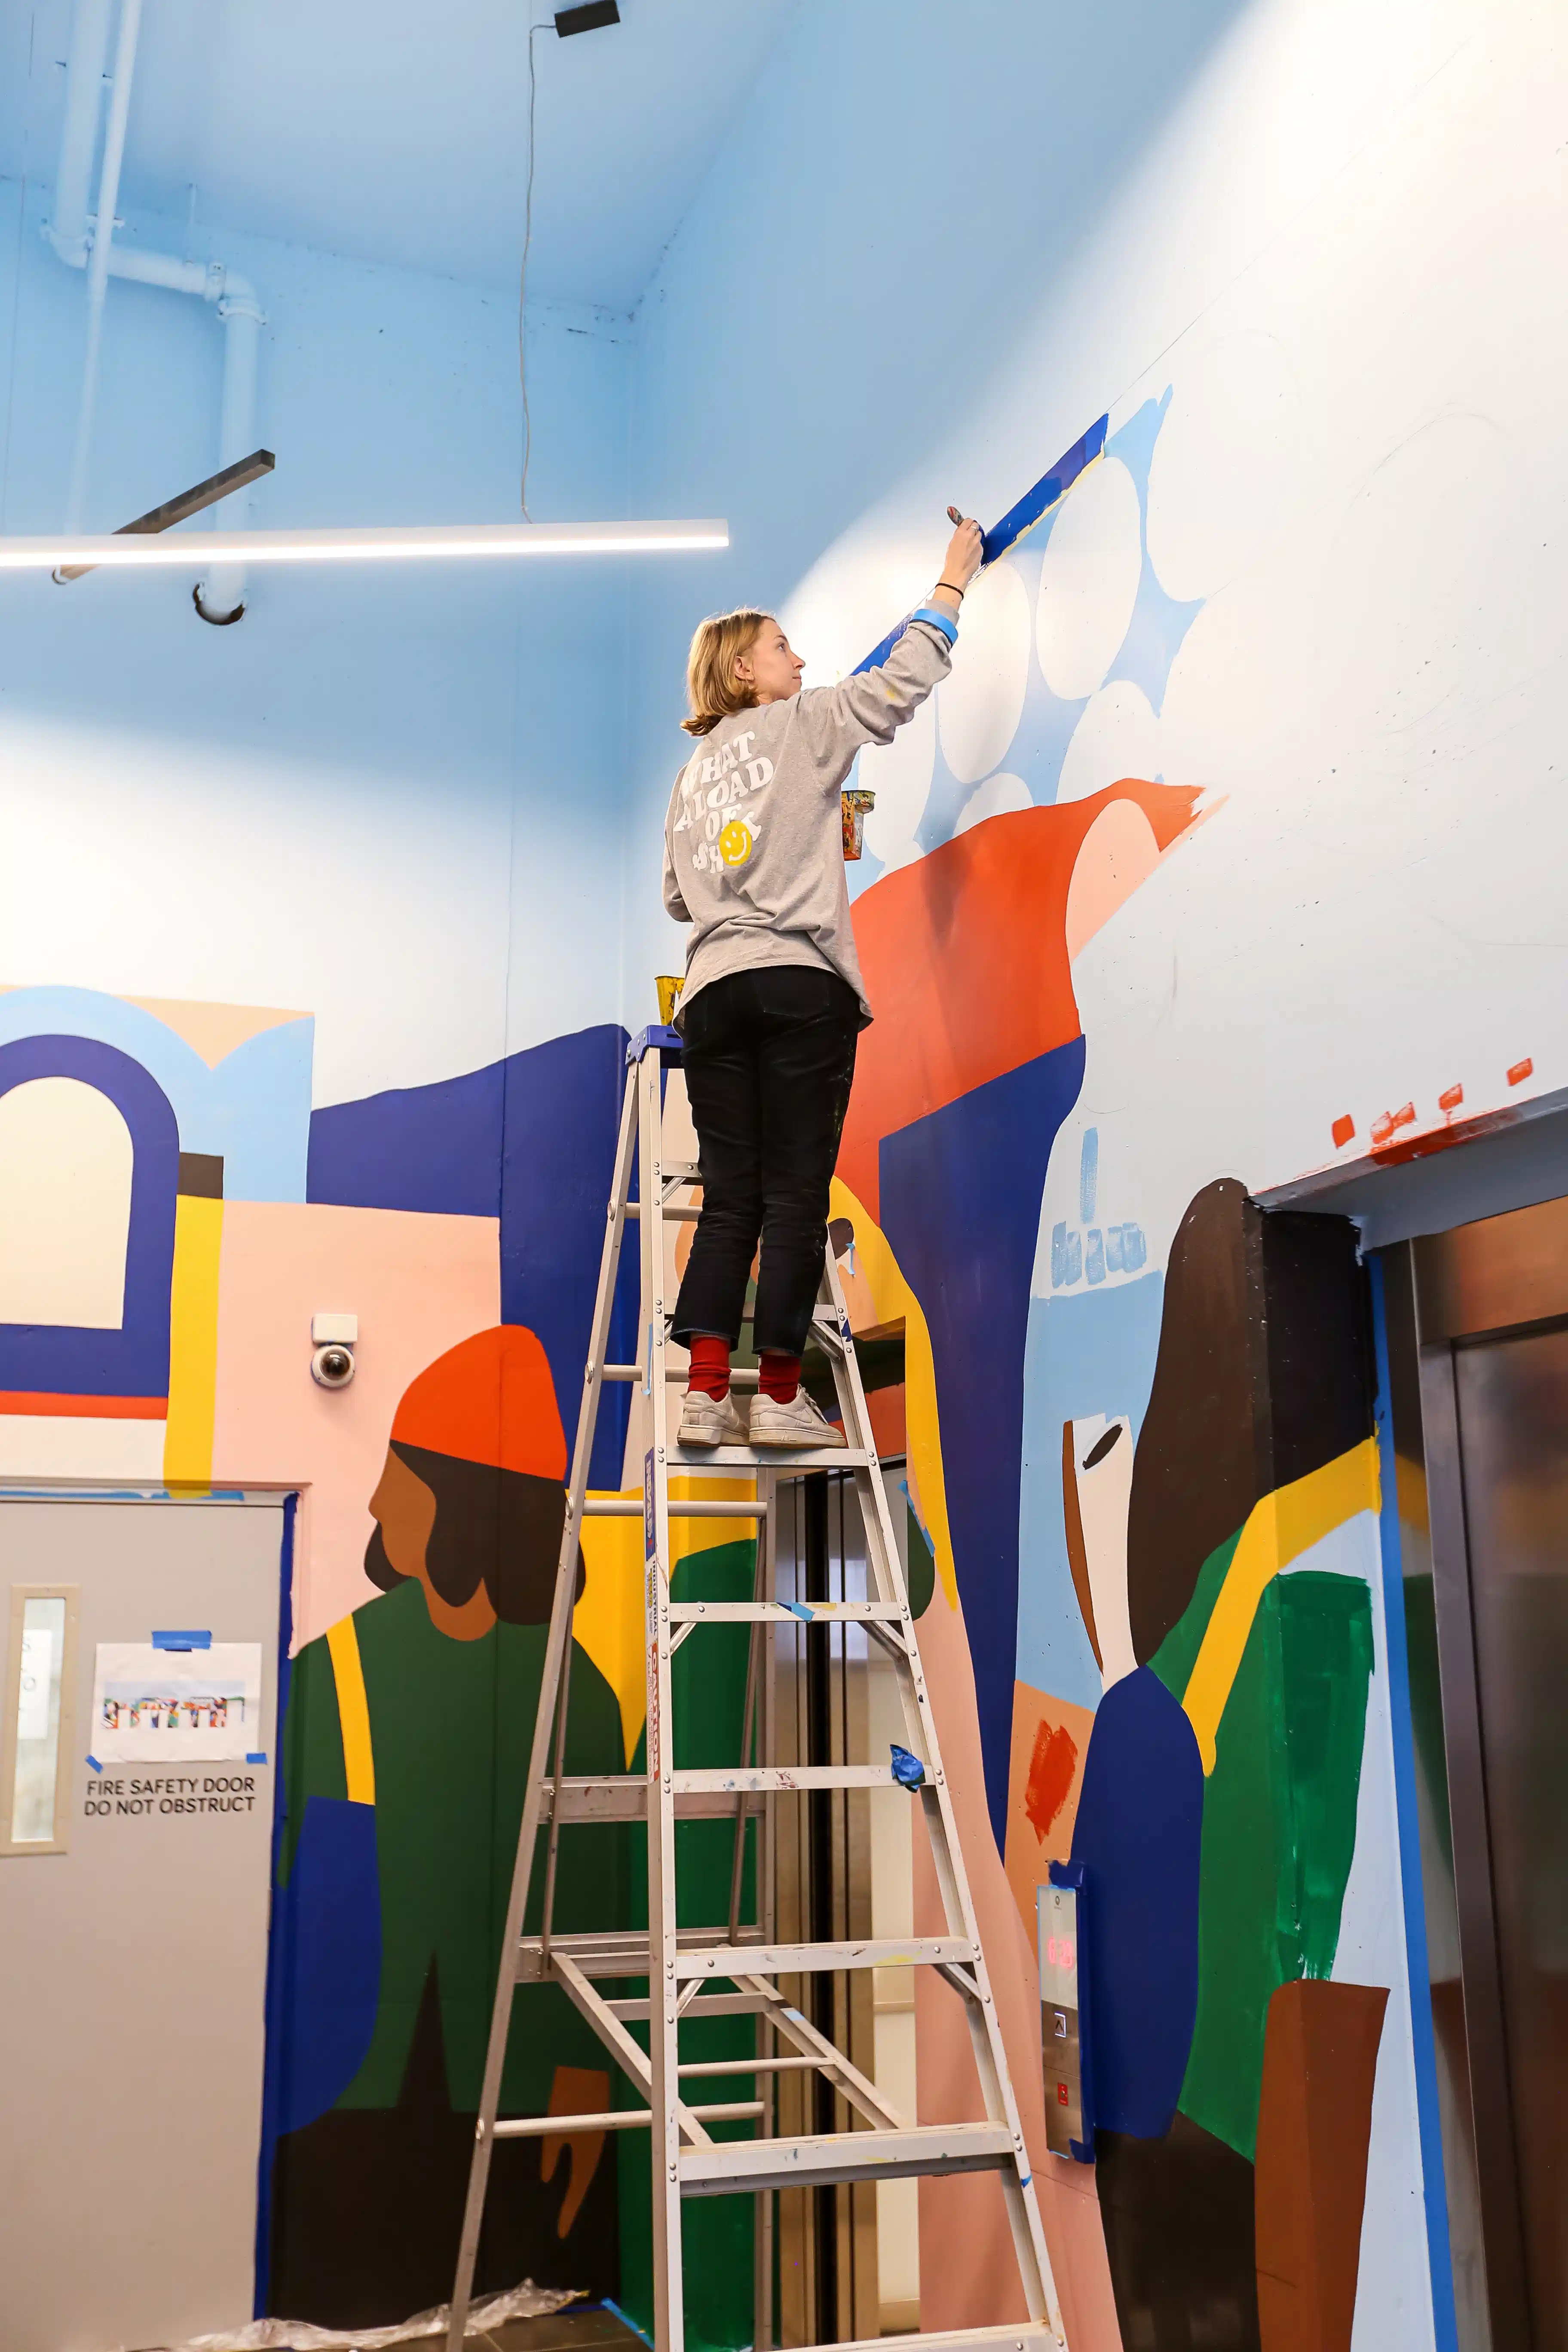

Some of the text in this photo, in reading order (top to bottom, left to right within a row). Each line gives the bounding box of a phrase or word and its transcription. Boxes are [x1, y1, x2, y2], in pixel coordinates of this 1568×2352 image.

[681, 731, 755, 797] WHAT
[673, 757, 774, 832] A LOAD
[705, 803, 742, 842] OF
[87, 1776, 255, 1795] FIRE SAFETY DOOR
[84, 1796, 256, 1816] DO NOT OBSTRUCT
